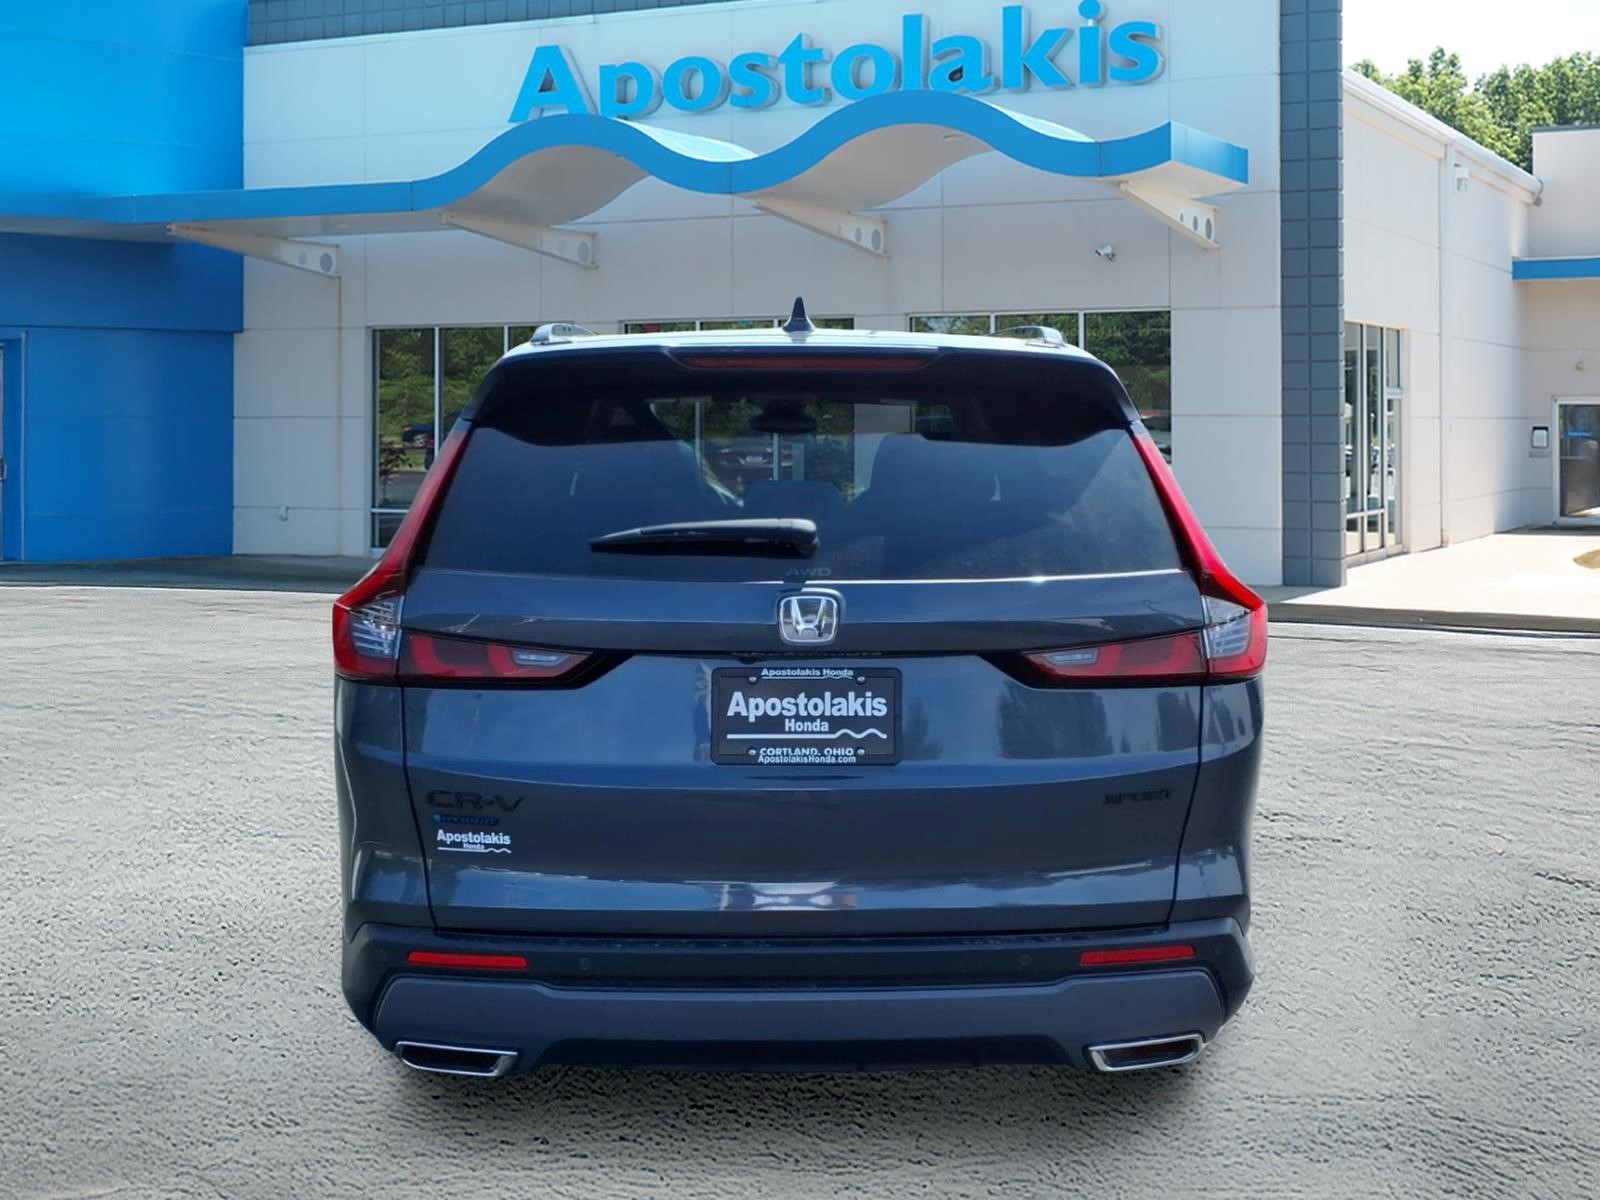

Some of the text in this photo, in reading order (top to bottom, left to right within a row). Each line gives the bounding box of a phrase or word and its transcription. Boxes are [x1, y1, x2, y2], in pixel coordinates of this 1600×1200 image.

[508, 0, 1162, 121] Apostolakis
[786, 567, 832, 577] AWD
[761, 668, 854, 677] Apostolakis Honda
[726, 691, 888, 723] Apostolakis
[784, 718, 829, 732] Honda
[824, 747, 854, 756] OHIO
[758, 754, 857, 764] ApostolakisHonda.com
[426, 789, 525, 812] CR-V
[437, 829, 511, 845] Apostolakis
[463, 842, 485, 850] Honda
